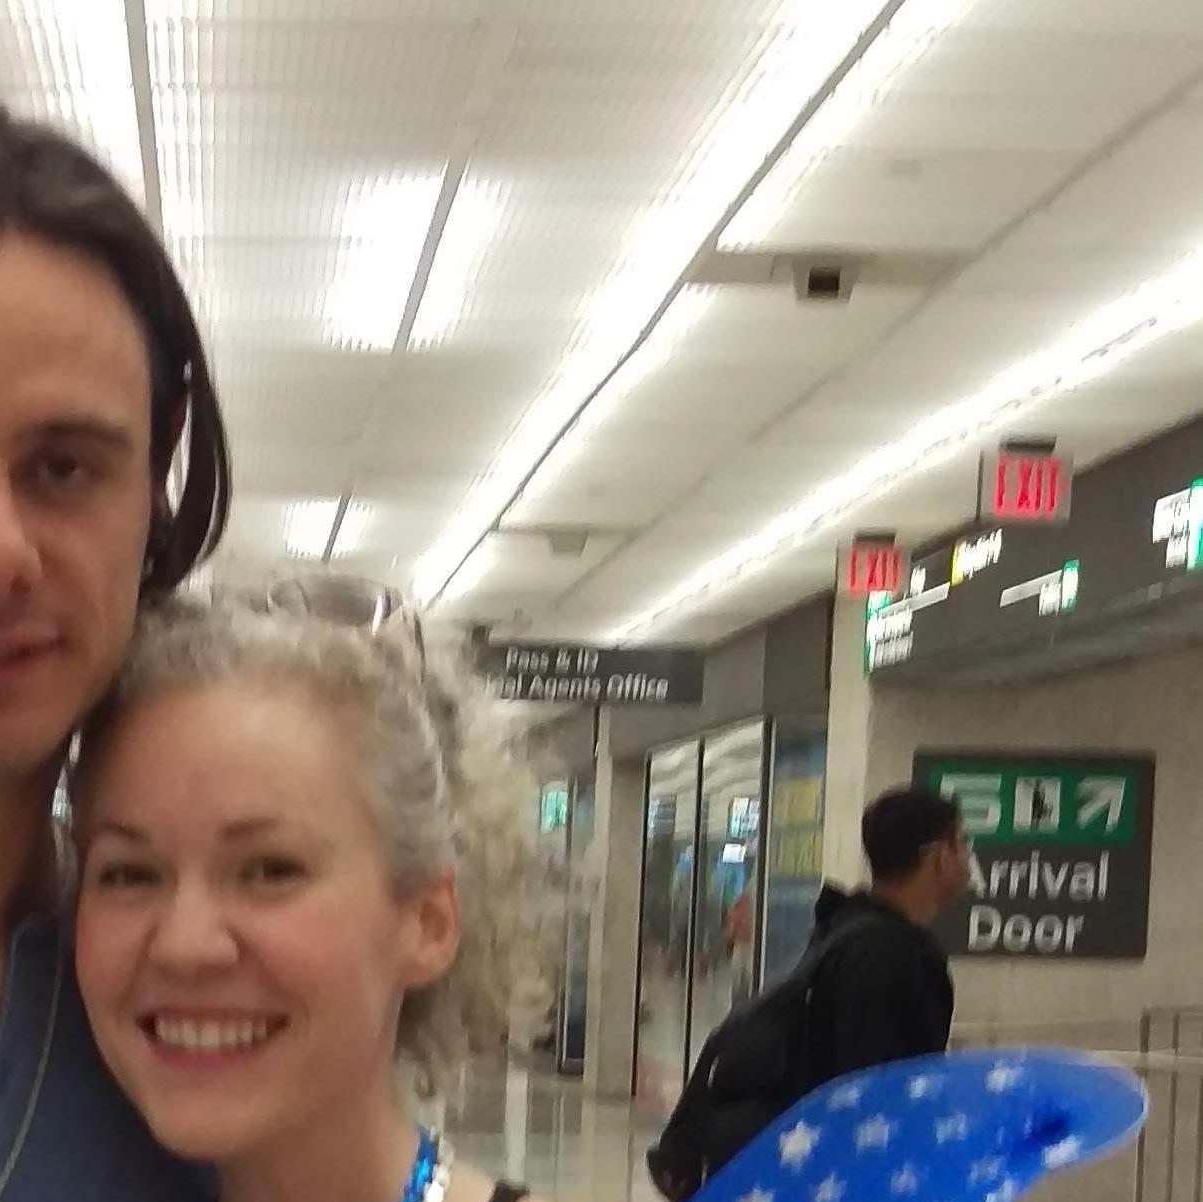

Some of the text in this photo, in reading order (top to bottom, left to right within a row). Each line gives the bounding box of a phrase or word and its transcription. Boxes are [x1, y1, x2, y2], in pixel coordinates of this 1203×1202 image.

[994, 456, 1060, 519] EXIT
[847, 546, 902, 594] EXIT
[607, 673, 669, 702] Office
[969, 905, 1084, 952] Door
